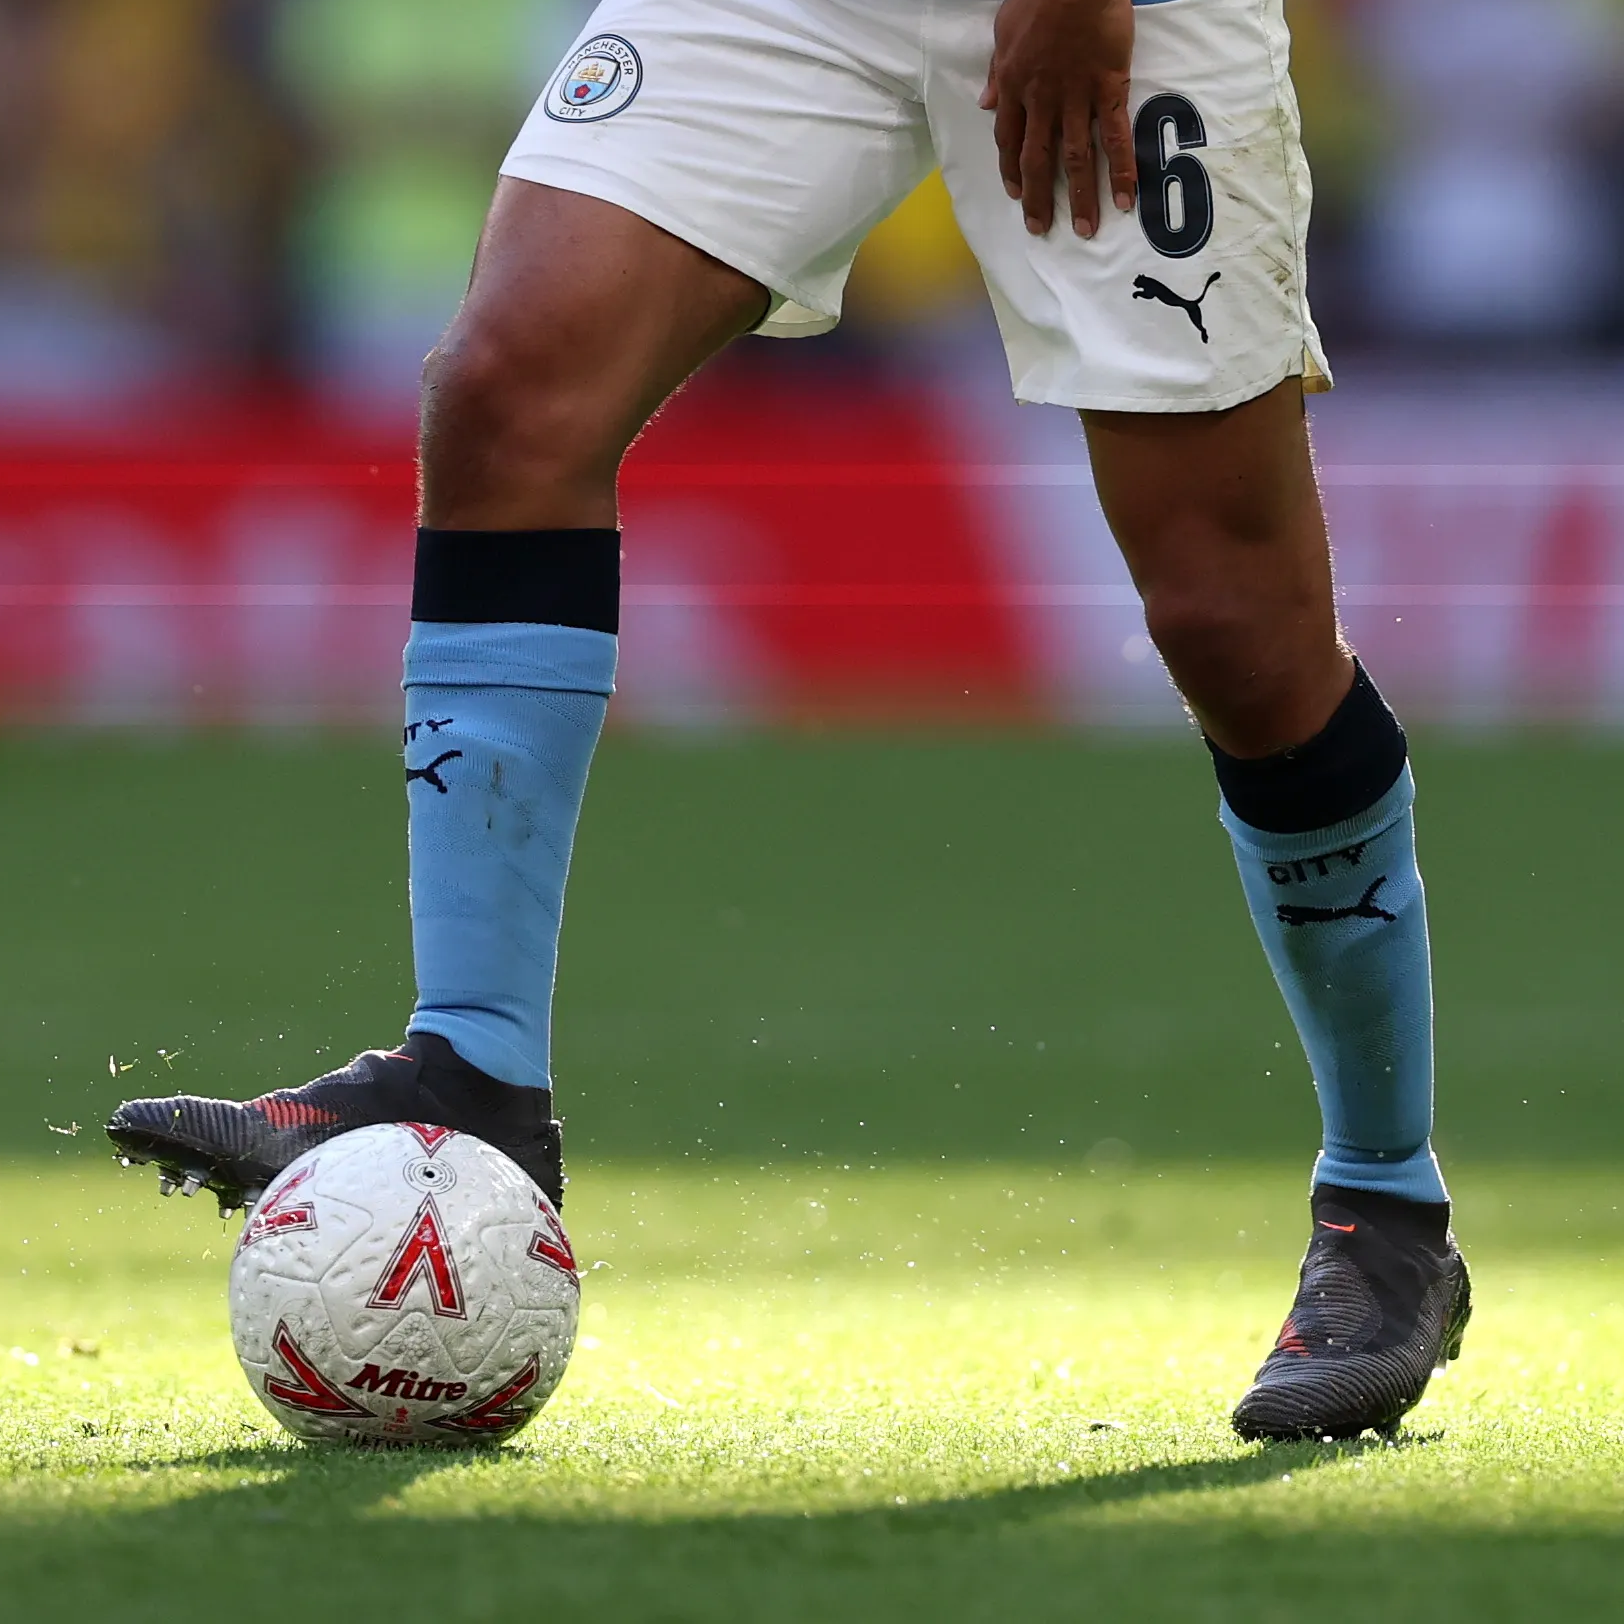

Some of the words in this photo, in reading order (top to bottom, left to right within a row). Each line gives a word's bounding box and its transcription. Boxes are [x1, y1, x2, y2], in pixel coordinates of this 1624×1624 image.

[567, 40, 634, 76] MANCHESTER
[558, 106, 587, 117] CITY
[1132, 92, 1214, 259] 6
[1267, 842, 1366, 885] CITY
[343, 1362, 468, 1402] Mitre
